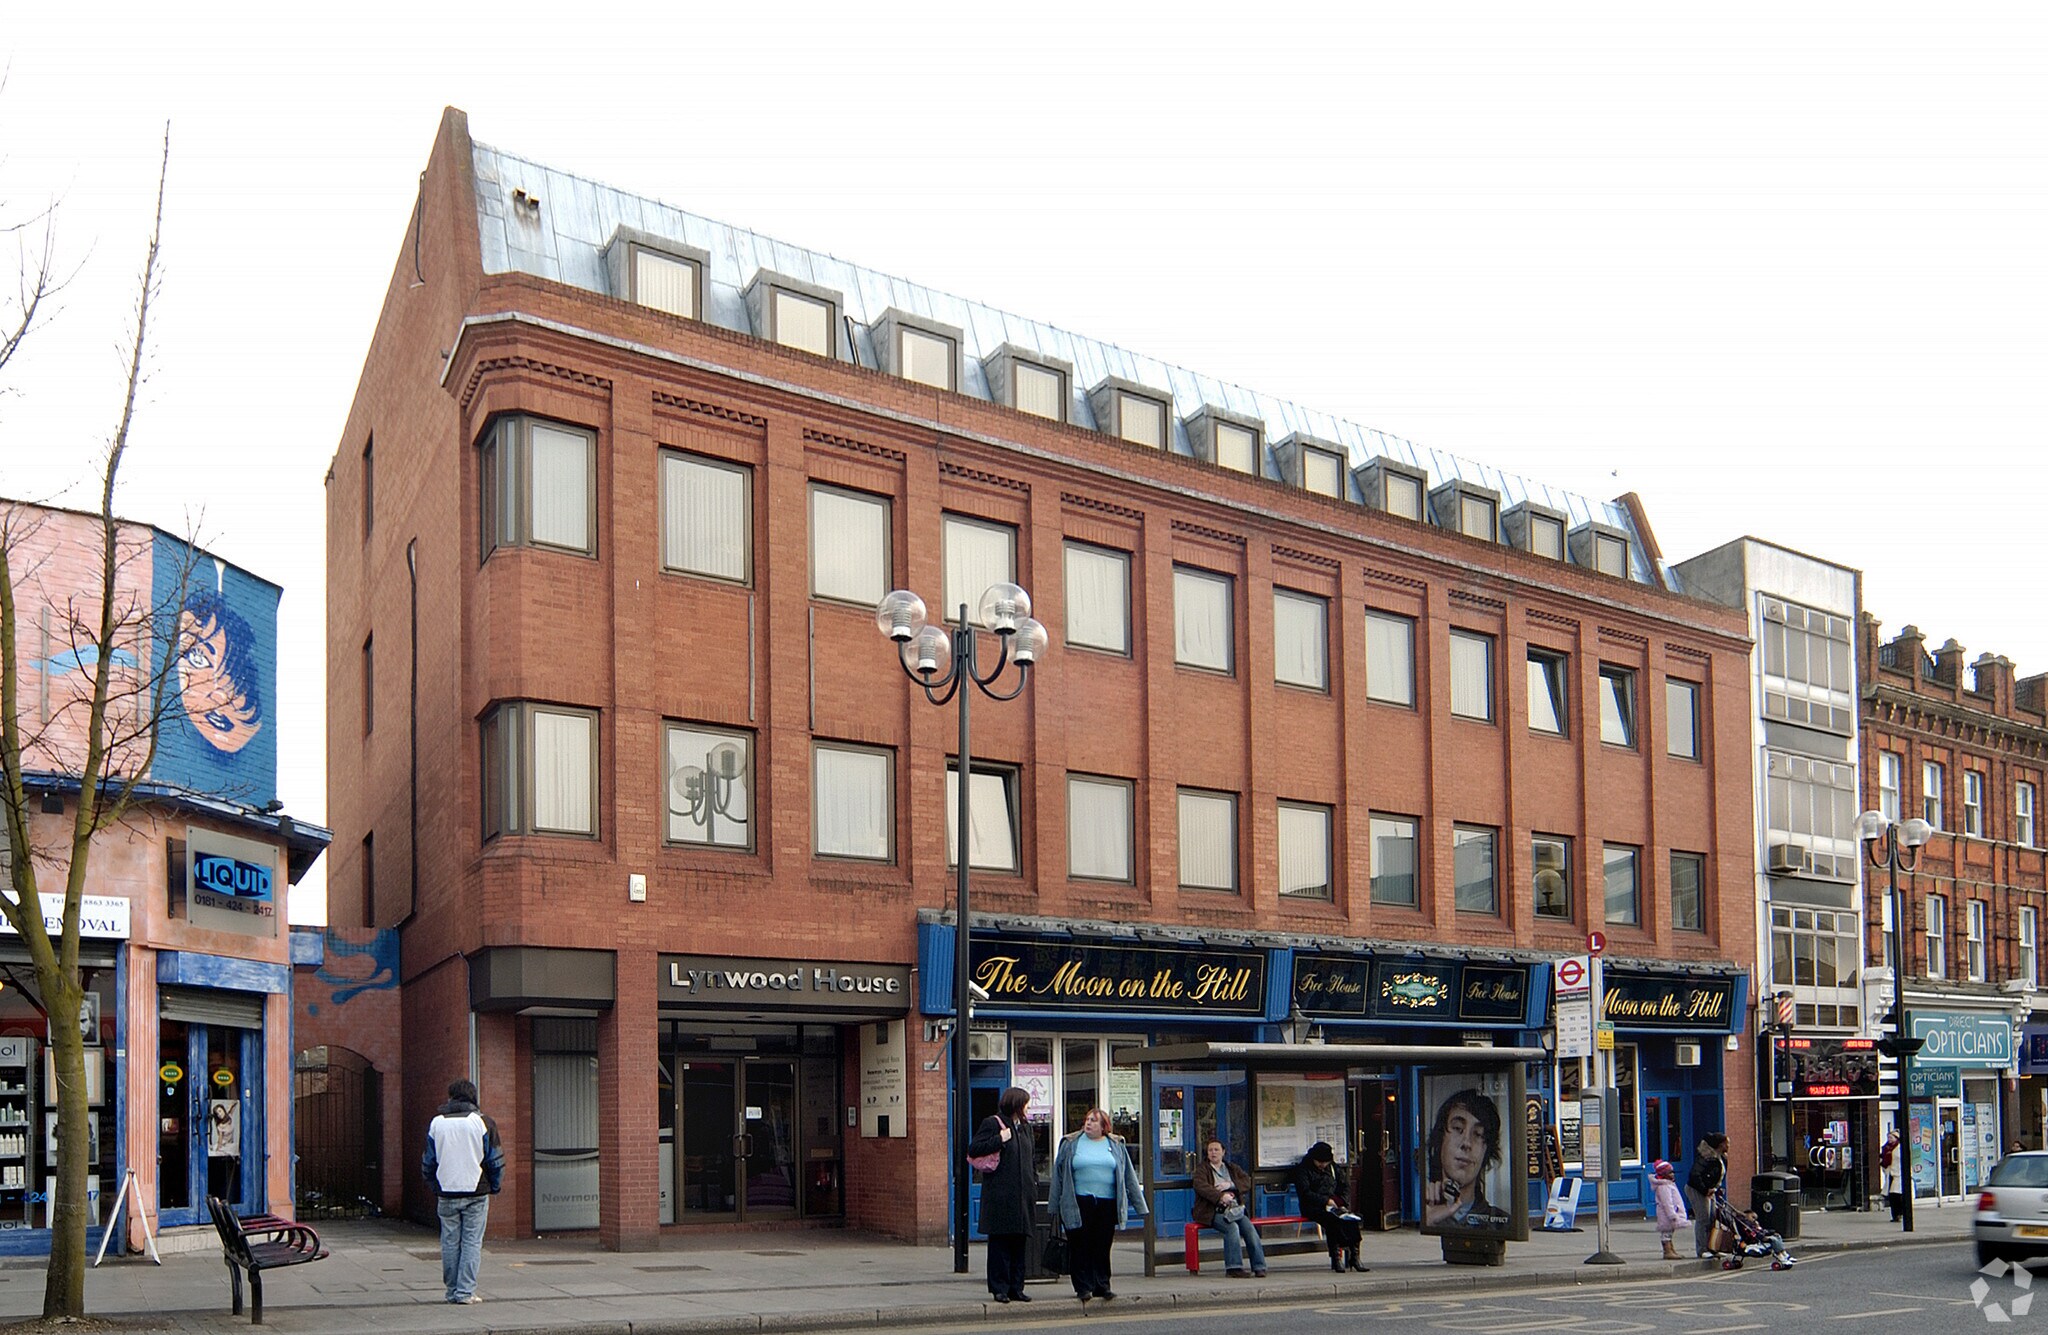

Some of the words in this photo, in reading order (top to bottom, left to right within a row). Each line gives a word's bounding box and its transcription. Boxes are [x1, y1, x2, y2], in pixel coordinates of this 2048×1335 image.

[199, 859, 268, 893] LIQUID
[195, 894, 215, 907] 0181
[226, 900, 243, 911] 424
[1591, 935, 1601, 950] L
[670, 962, 804, 994] Lynwood
[813, 968, 900, 993] House
[976, 956, 1028, 993] The
[1031, 960, 1114, 998] Moon
[1118, 977, 1147, 998] on
[1149, 968, 1183, 999] the
[1187, 963, 1251, 1004] Hill
[1298, 973, 1324, 993] Free
[1326, 974, 1362, 995] House
[1465, 981, 1487, 1001] Free
[1488, 982, 1520, 1001] House
[1602, 988, 1638, 1015] Moon
[1640, 1000, 1657, 1016] on
[1659, 994, 1681, 1017] the
[1684, 990, 1724, 1020] Hill
[1926, 1030, 2003, 1054] OPTICIANS
[1910, 1072, 1954, 1082] OPTICIANS
[542, 1193, 598, 1203] Newman
